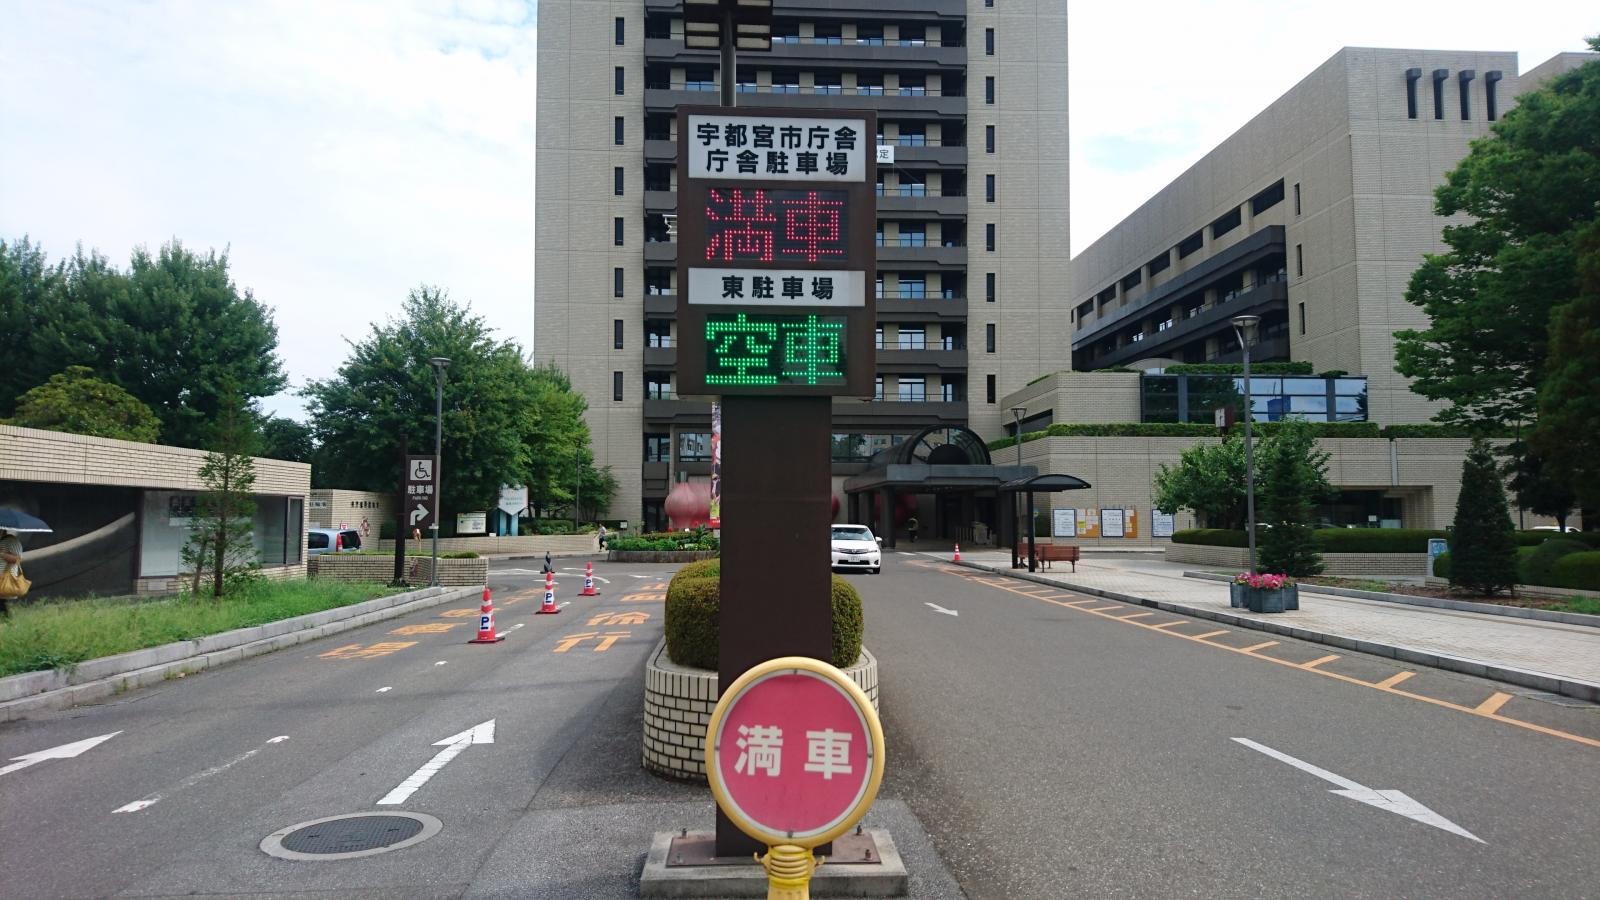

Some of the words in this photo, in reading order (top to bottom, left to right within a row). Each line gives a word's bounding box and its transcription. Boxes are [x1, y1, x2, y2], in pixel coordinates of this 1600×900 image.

[697, 123, 857, 150] 宇都宮市庁舎
[706, 149, 849, 175] 庁舎駐車場
[706, 189, 843, 262] 満車
[721, 275, 834, 300] 東駐車場
[706, 313, 843, 384] 空車
[407, 485, 434, 495] 駐車場
[545, 592, 553, 601] P
[481, 616, 490, 627] P
[734, 724, 853, 780] 満車
